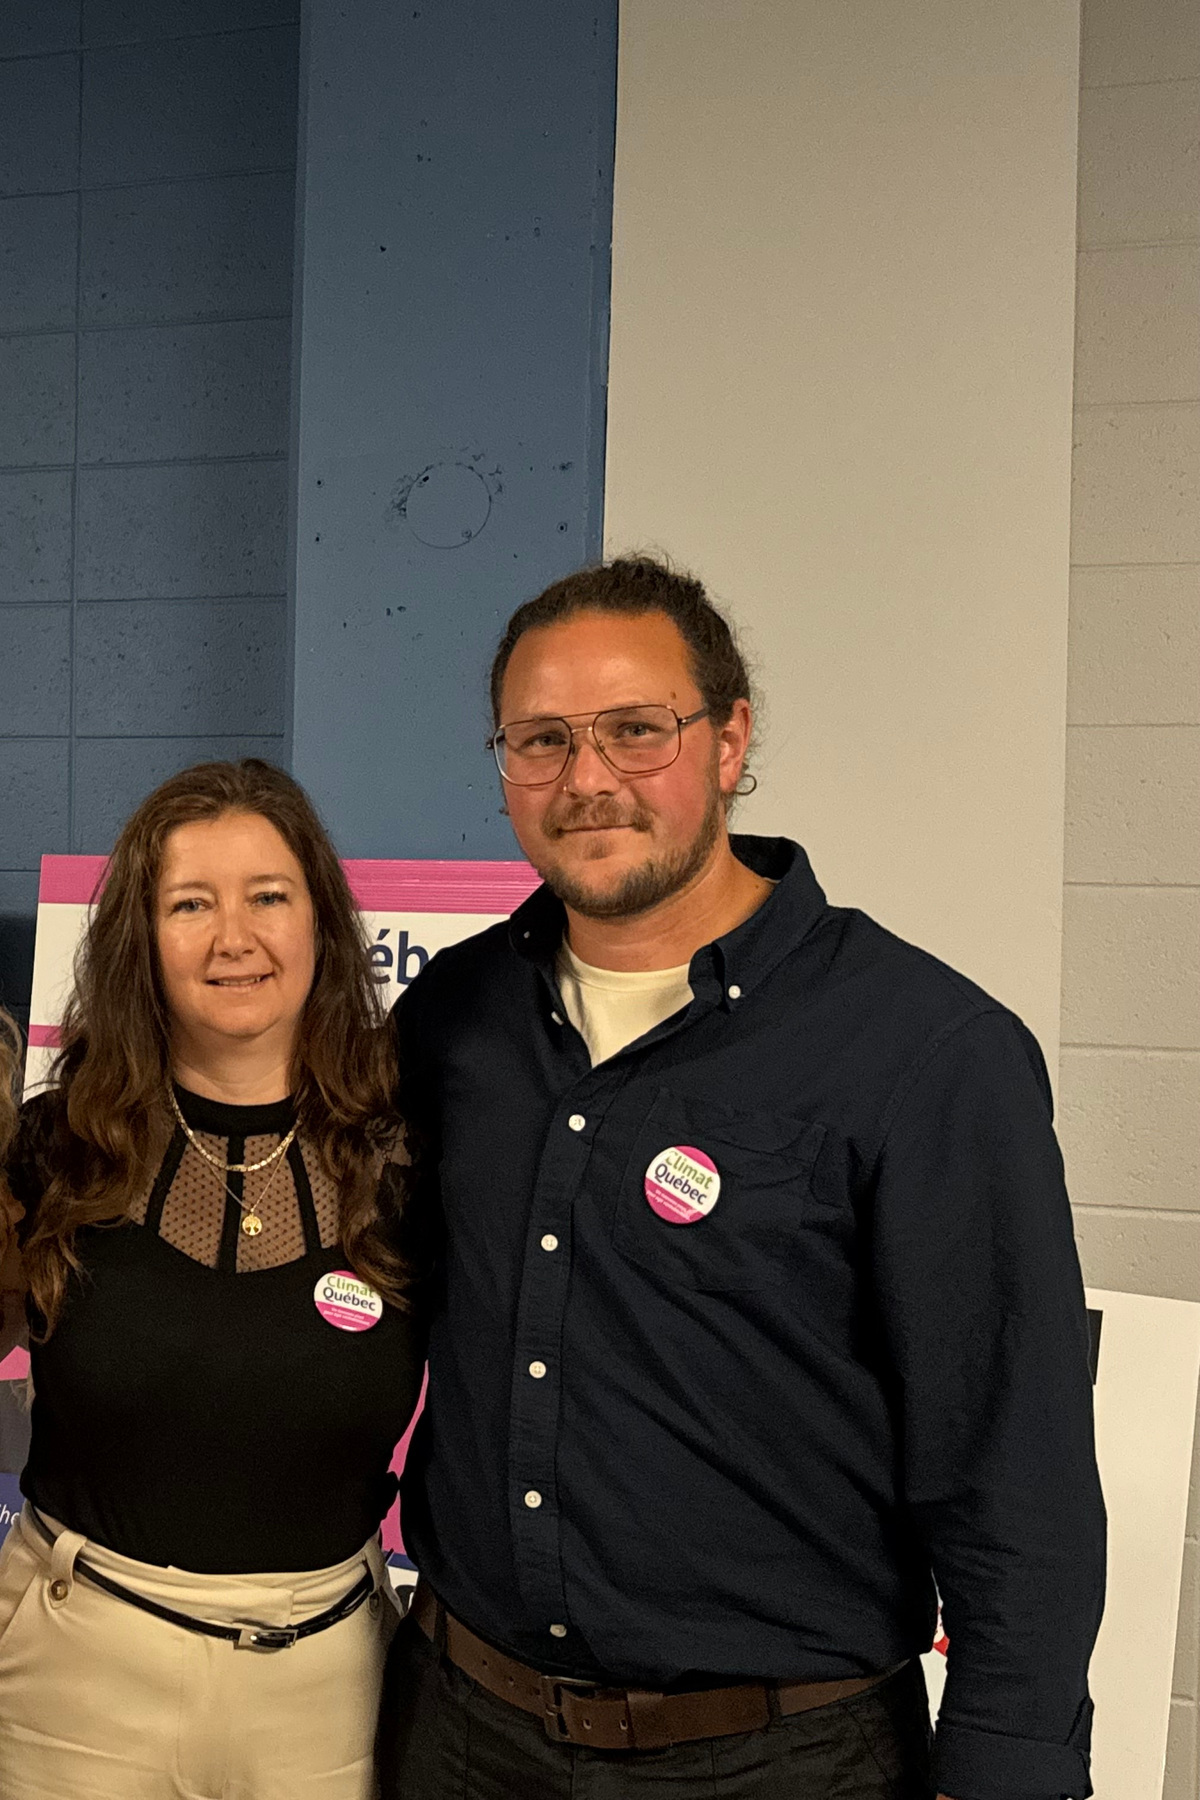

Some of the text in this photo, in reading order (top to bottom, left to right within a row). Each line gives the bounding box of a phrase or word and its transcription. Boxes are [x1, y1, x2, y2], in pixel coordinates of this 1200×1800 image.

[654, 1163, 708, 1206] Québec
[666, 1151, 714, 1190] Climat
[322, 1286, 377, 1312] Québec
